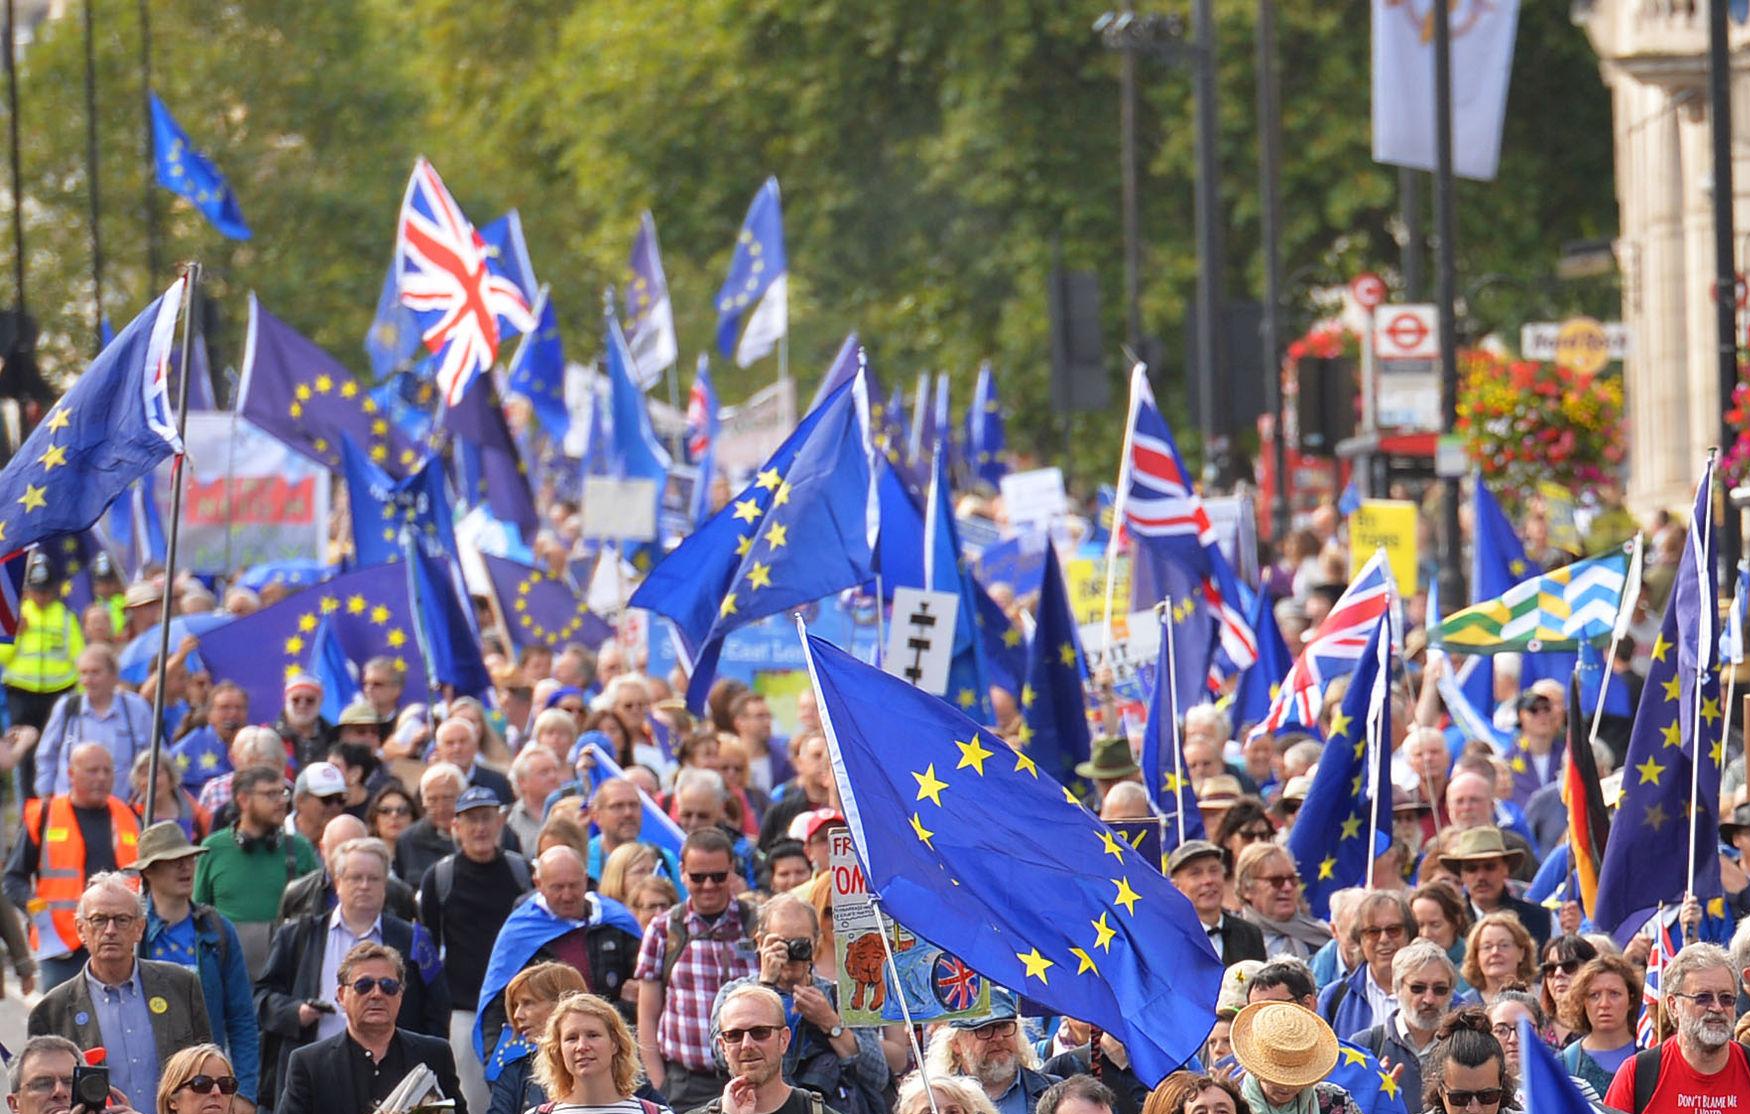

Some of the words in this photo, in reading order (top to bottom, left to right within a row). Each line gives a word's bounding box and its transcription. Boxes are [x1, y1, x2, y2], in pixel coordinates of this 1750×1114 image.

[1678, 1093, 1701, 1107] DON'T
[1702, 1095, 1726, 1109] BLAME
[1728, 1095, 1738, 1107] ME
